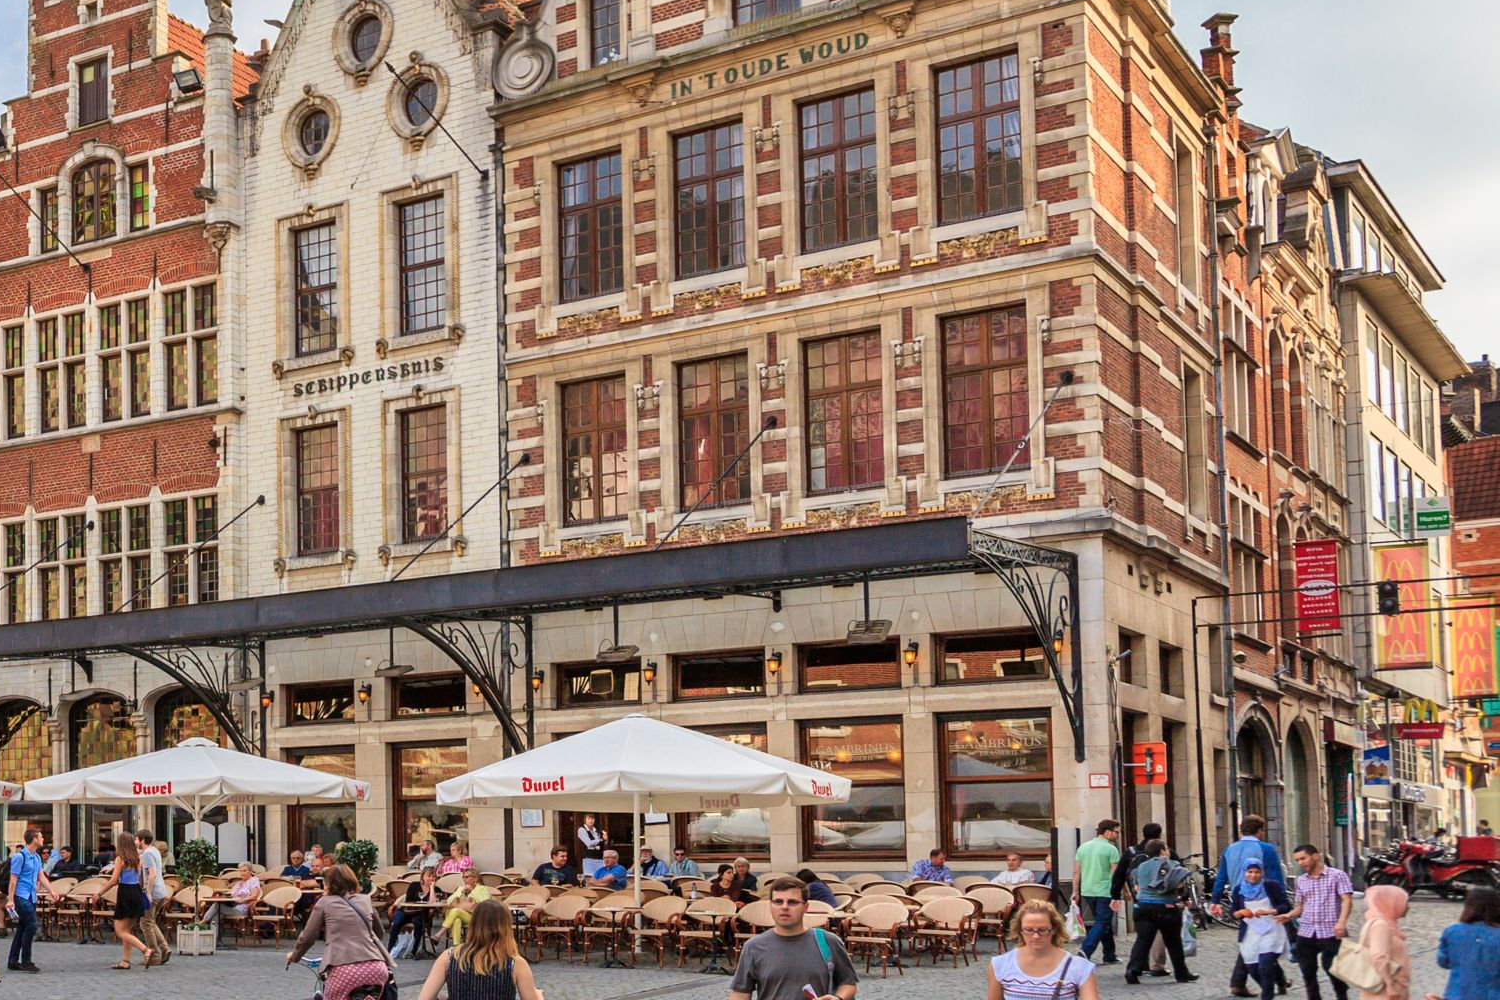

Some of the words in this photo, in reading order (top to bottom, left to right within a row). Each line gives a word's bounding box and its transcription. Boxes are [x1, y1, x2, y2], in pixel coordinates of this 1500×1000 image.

[670, 78, 693, 100] IN
[724, 53, 790, 84] OUDE
[798, 32, 870, 65] WOUD
[132, 781, 172, 796] Duvel
[522, 776, 566, 793] Duvel
[811, 779, 833, 797] Duvel
